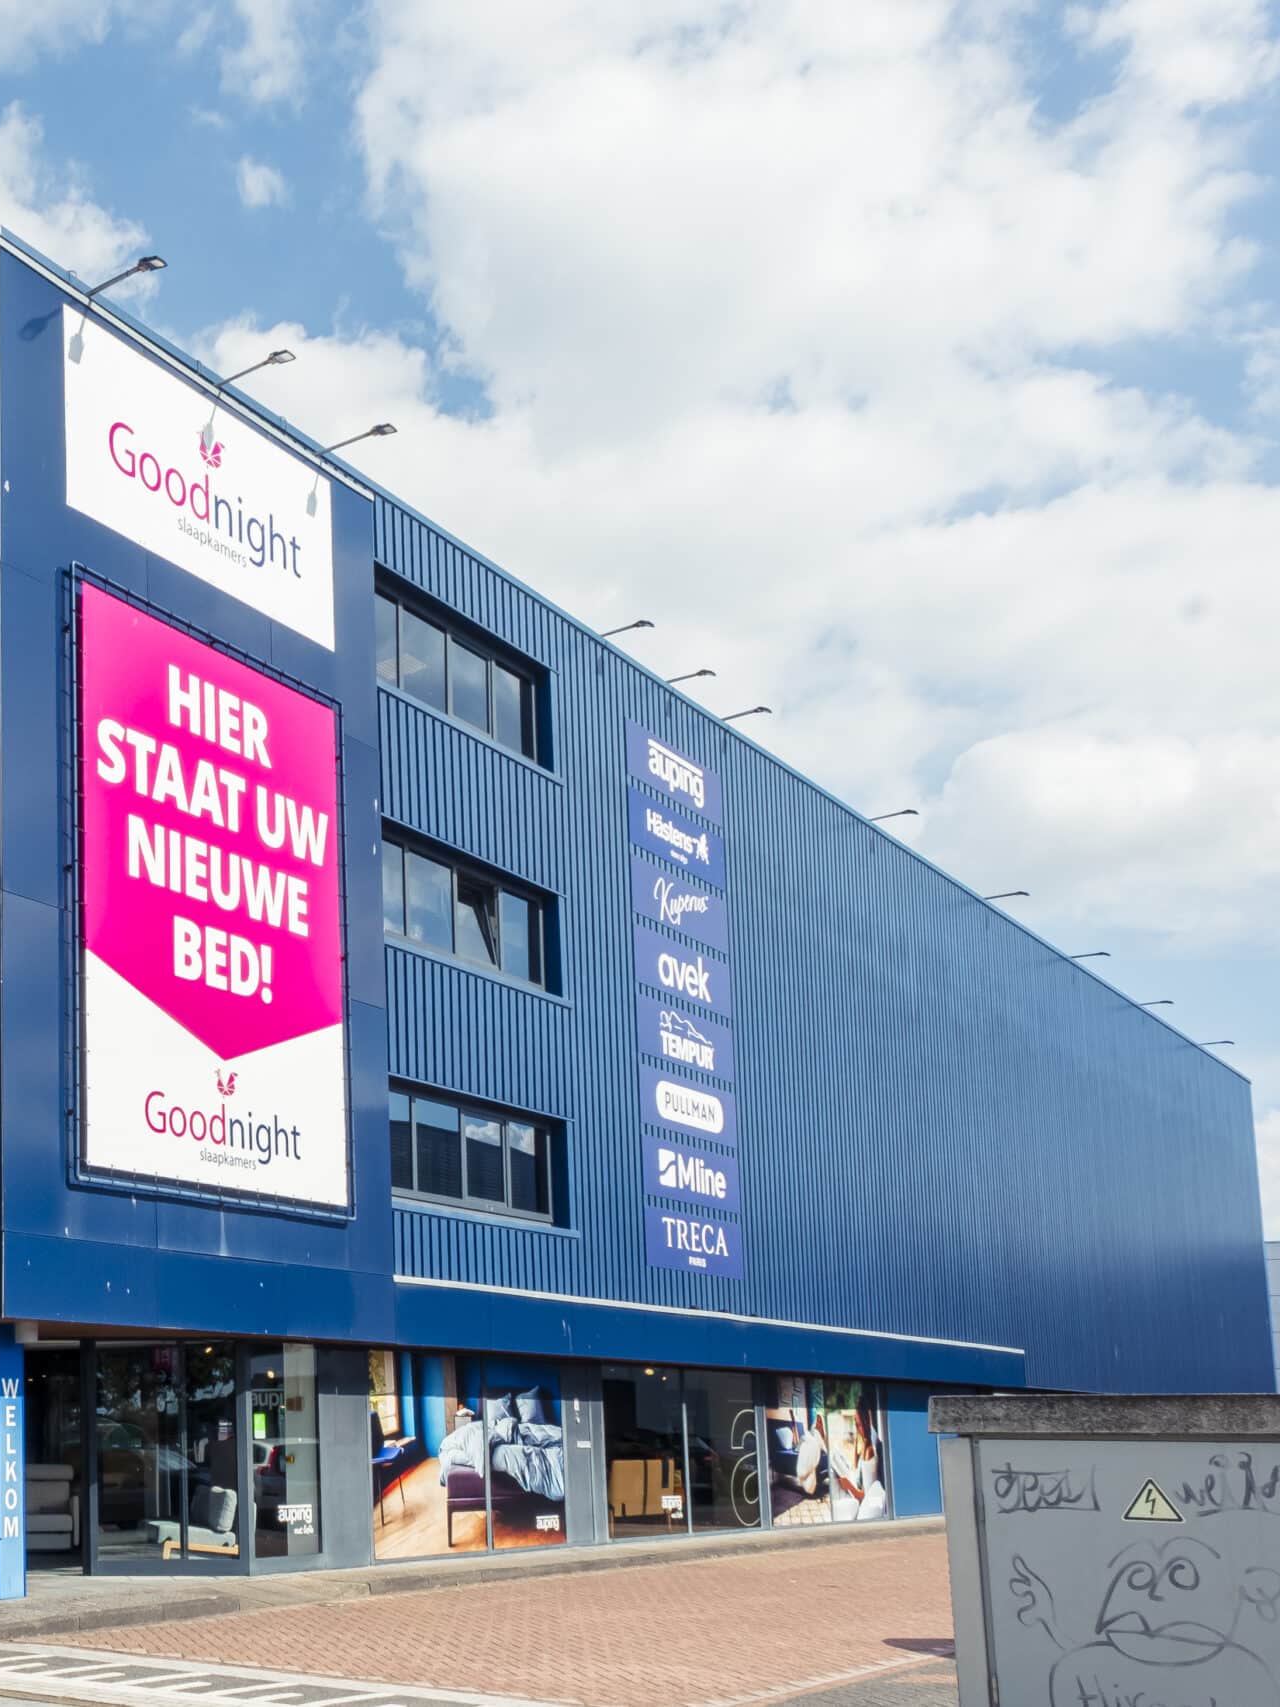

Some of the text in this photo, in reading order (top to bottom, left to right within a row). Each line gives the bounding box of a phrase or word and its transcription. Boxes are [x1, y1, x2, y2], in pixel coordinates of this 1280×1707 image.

[109, 422, 302, 579] Goodnight
[177, 516, 248, 569] slaapkamers
[167, 664, 272, 769] HIER
[96, 718, 328, 868] STAAT UW
[647, 741, 705, 808] auping
[646, 808, 694, 854] Hästens
[127, 813, 310, 938] NIEUWE
[172, 916, 274, 1005] BED!
[658, 953, 712, 1003] avek
[660, 1029, 715, 1071] TEMPUR
[144, 1090, 302, 1168] Goodnight
[664, 1090, 716, 1125] PULLMAN
[199, 1147, 258, 1172] slaapkamers
[677, 1153, 727, 1199] Mline
[661, 1216, 729, 1257] TRECA
[1, 1378, 20, 1538] WELKOM
[278, 1504, 312, 1525] auping
